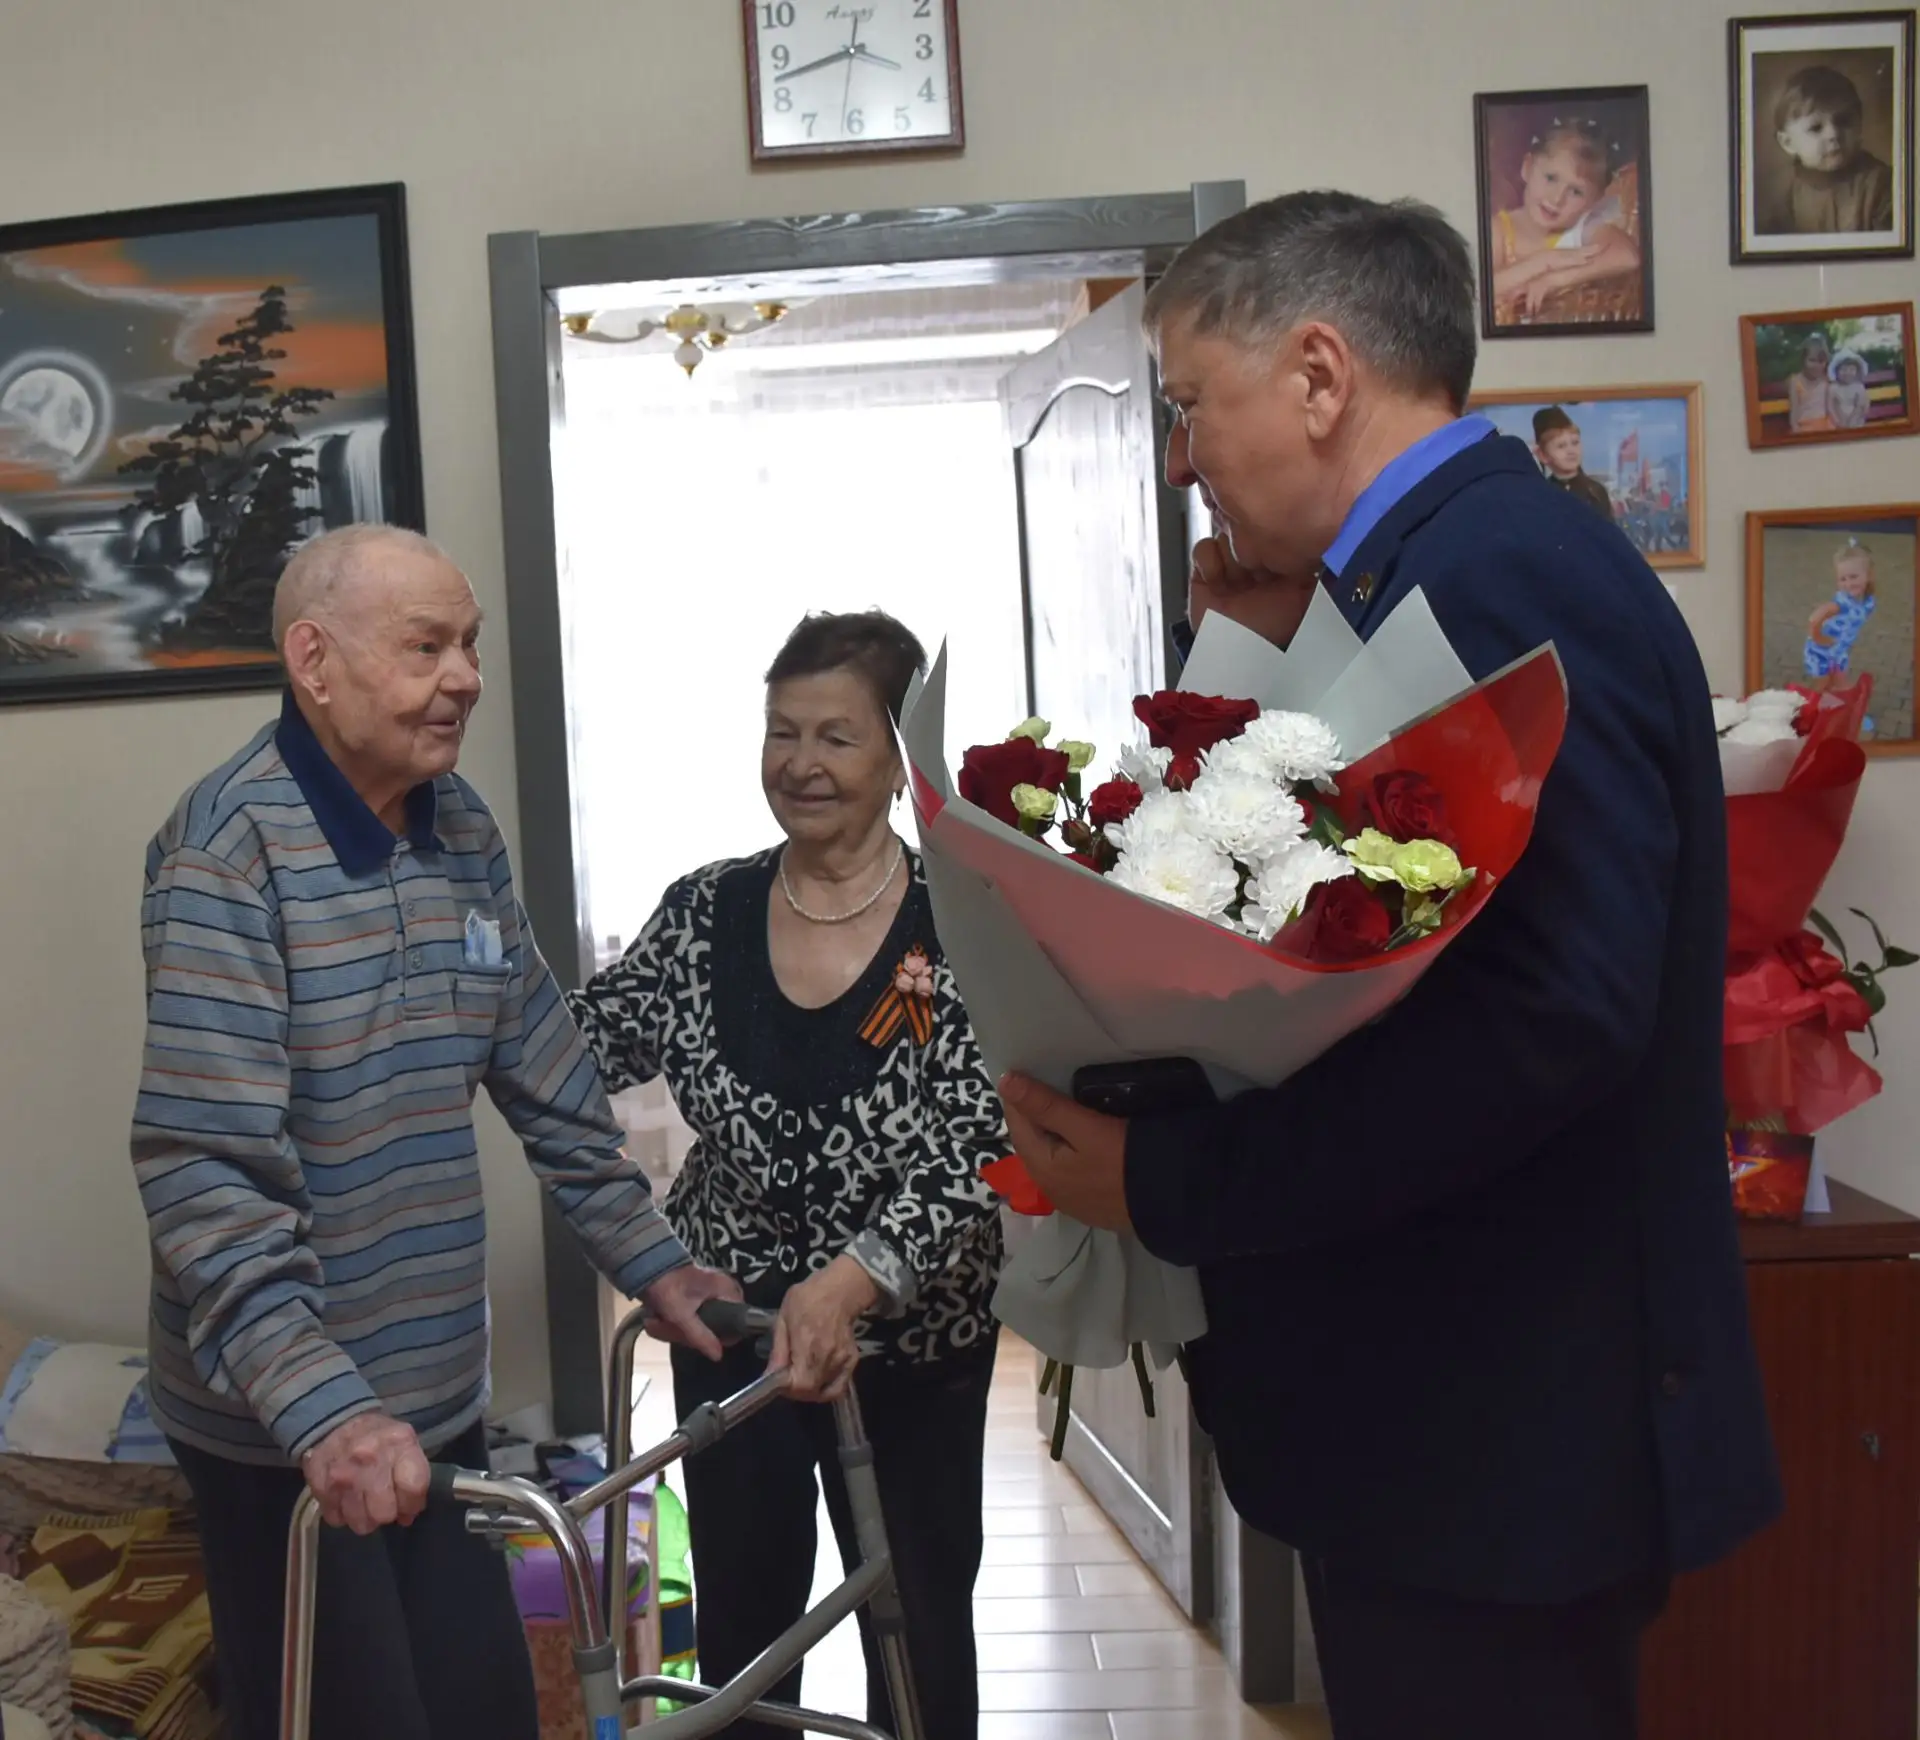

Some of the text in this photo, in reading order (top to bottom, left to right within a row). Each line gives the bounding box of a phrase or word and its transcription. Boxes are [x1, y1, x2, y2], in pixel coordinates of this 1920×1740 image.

[762, 2, 795, 29] 10
[913, 0, 931, 18] 2
[771, 44, 790, 70] 9
[915, 34, 933, 60] 3
[774, 87, 793, 113] 8
[917, 77, 936, 103] 4
[801, 113, 818, 138] 7
[846, 109, 865, 134] 6
[894, 106, 911, 132] 5
